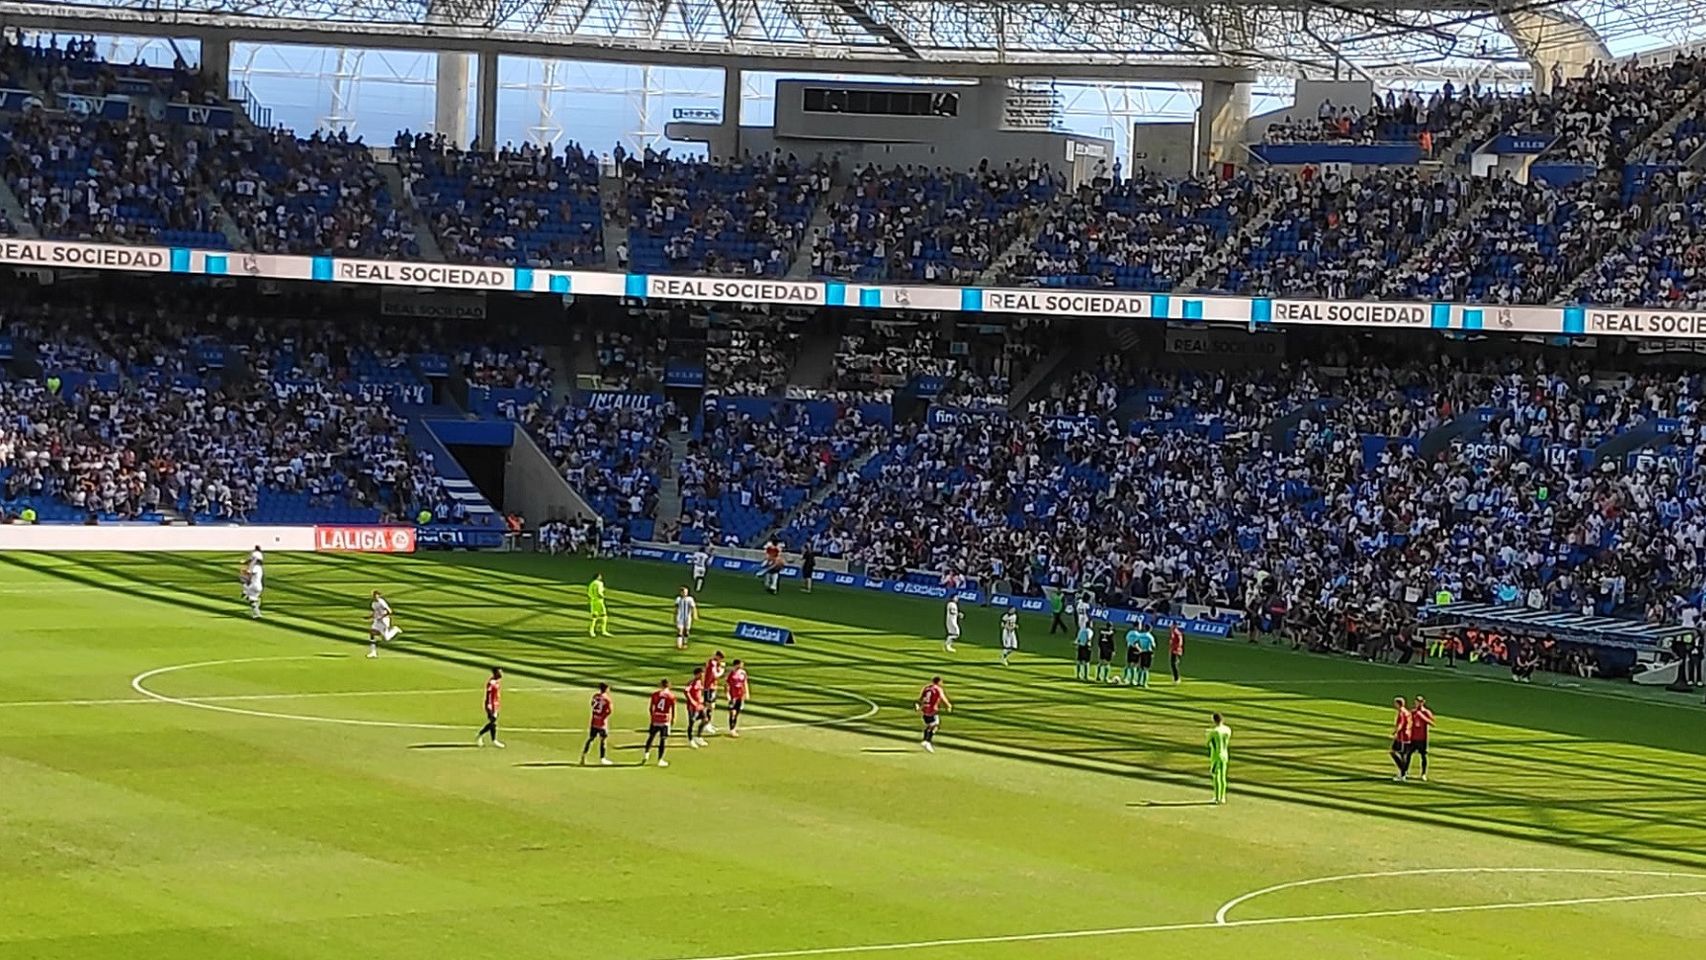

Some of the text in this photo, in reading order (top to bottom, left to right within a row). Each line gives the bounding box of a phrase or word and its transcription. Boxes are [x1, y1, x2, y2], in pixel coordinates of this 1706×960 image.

[0, 243, 163, 267] EAL SOCIEDAD
[340, 262, 505, 286] REAL SOCIEDAD
[652, 279, 818, 301] REAL SOCIEDAD
[989, 293, 1142, 314] REAL SOCIEDAD
[1275, 303, 1425, 324] REAL SOCIEDAD
[1591, 313, 1644, 331] REAL
[320, 530, 387, 549] LALIGA
[657, 698, 666, 711] 4
